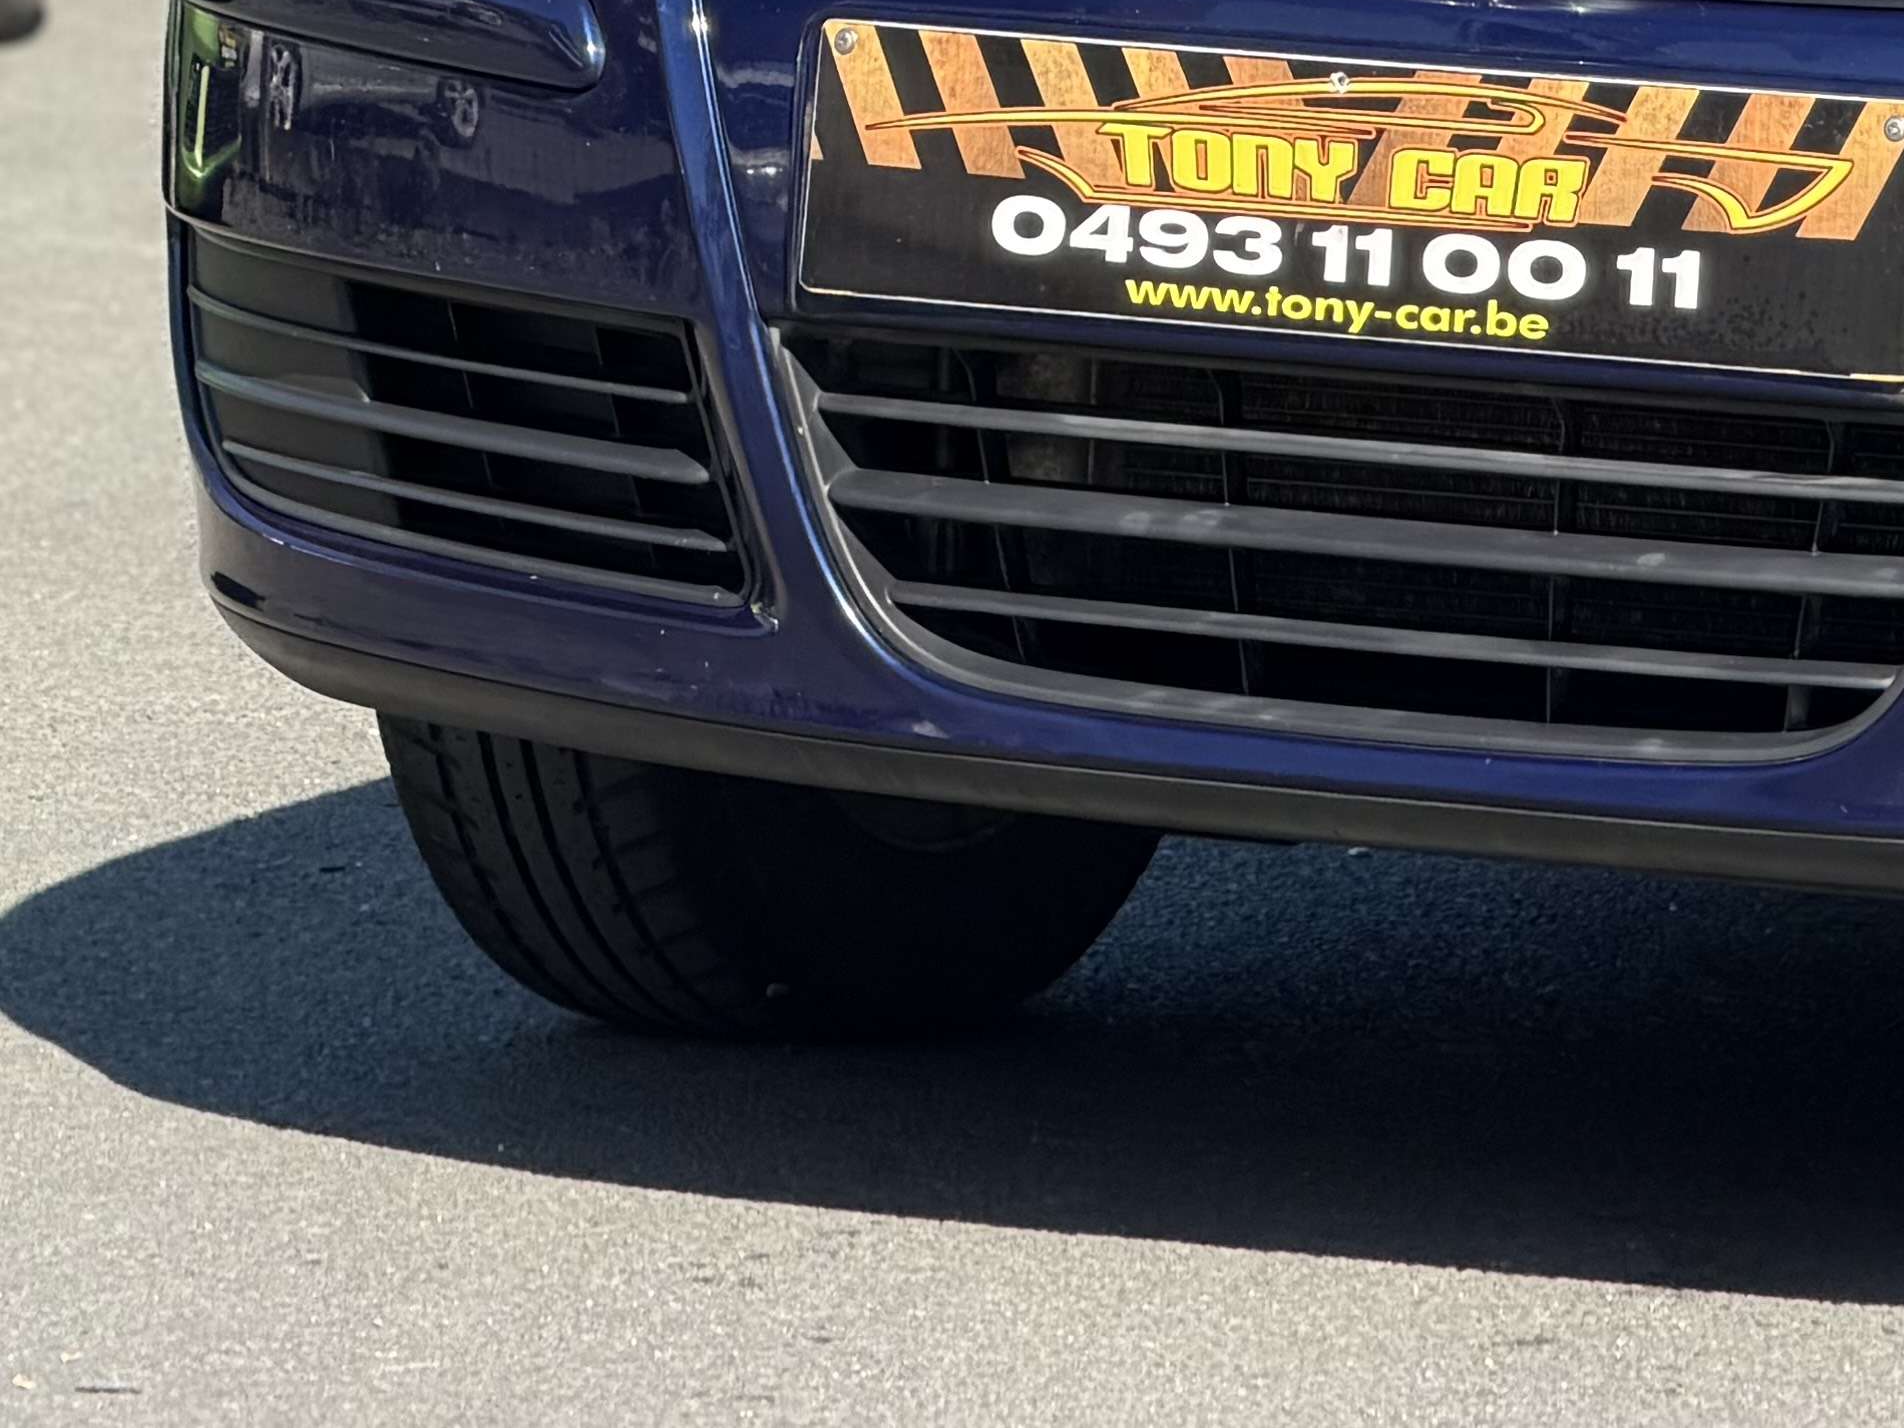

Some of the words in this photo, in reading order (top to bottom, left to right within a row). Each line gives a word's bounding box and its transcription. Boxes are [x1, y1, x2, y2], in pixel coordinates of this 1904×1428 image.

[1097, 121, 1359, 204] TONY
[1389, 148, 1590, 224] CAR
[991, 194, 1284, 277] 0493
[1311, 224, 1394, 288] 11
[1421, 233, 1588, 302] 00
[1616, 246, 1702, 311] 11
[1126, 275, 1550, 341] www.tony-car.be
